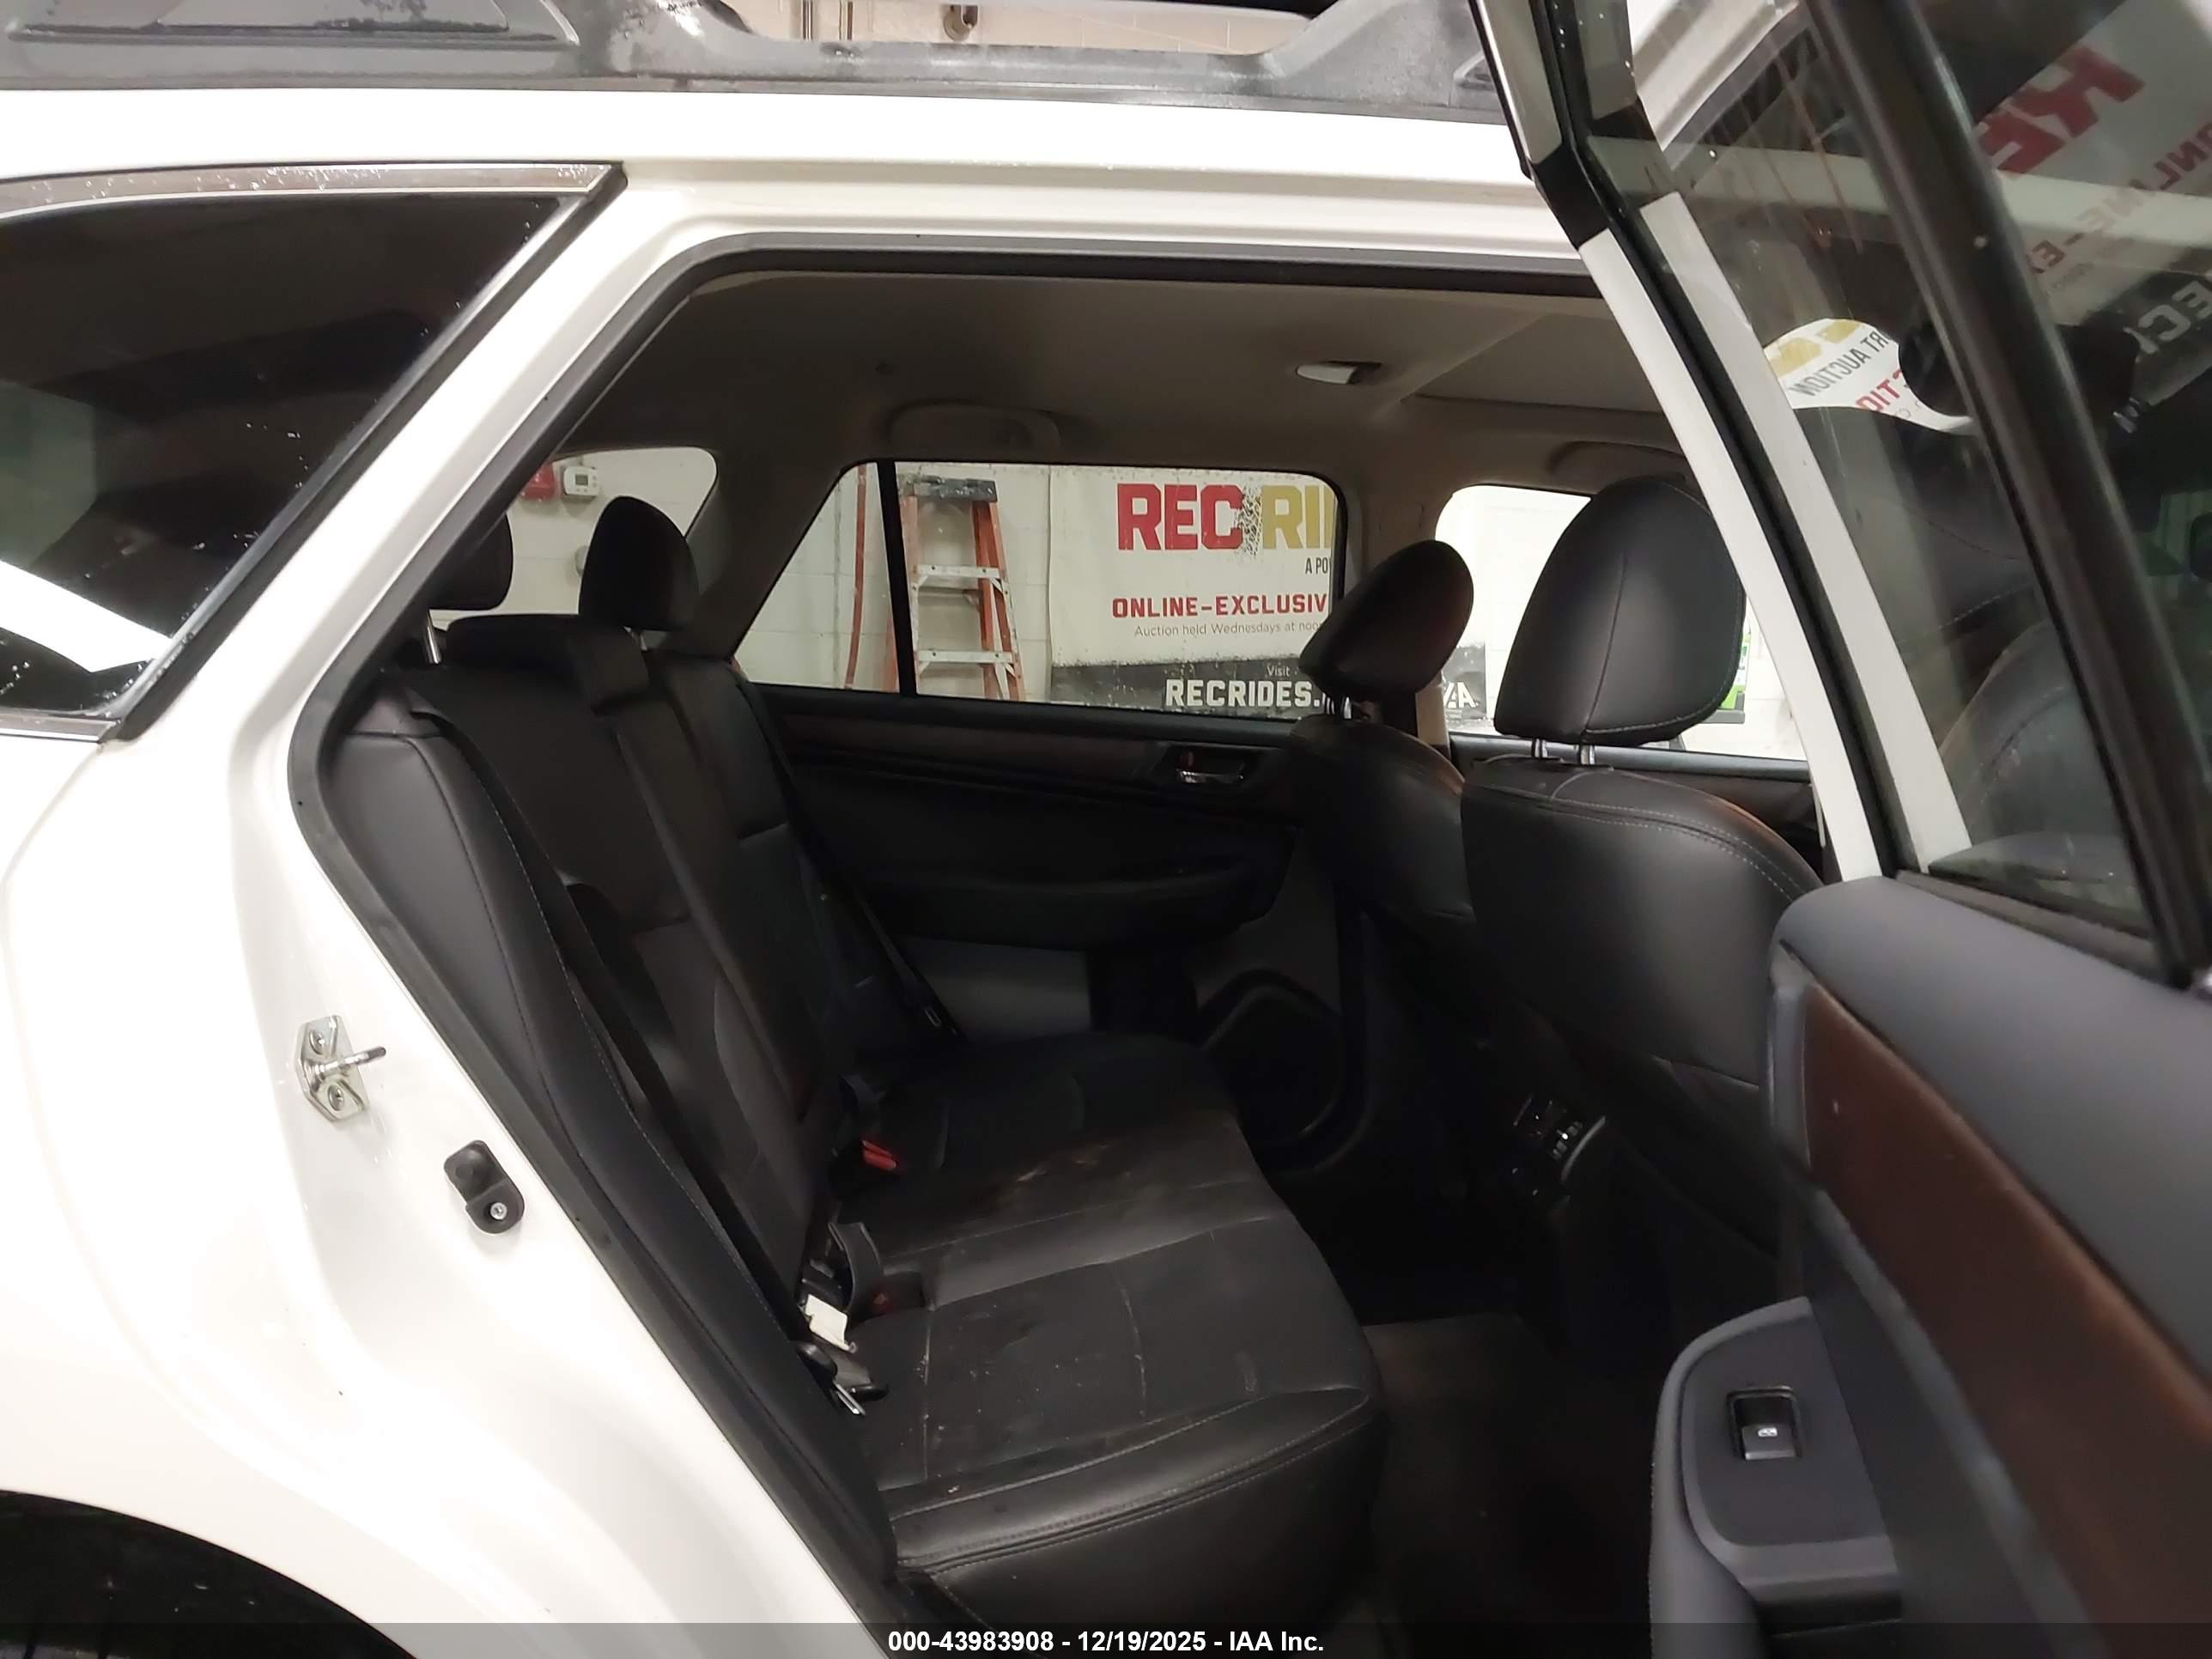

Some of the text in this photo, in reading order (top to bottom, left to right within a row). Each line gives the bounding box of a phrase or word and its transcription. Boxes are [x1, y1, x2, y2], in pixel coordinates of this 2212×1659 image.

[1261, 484, 1334, 550] RI
[1305, 556, 1332, 574] A PO
[1112, 593, 1328, 618] ONLINE-EXCLUSIV
[1134, 624, 1179, 637] Auction
[1182, 623, 1207, 635] held
[1211, 621, 1281, 635] Wednesdays
[1284, 621, 1296, 632] at
[1266, 665, 1291, 678] Visit
[1165, 678, 1322, 708] RECRIDES.
